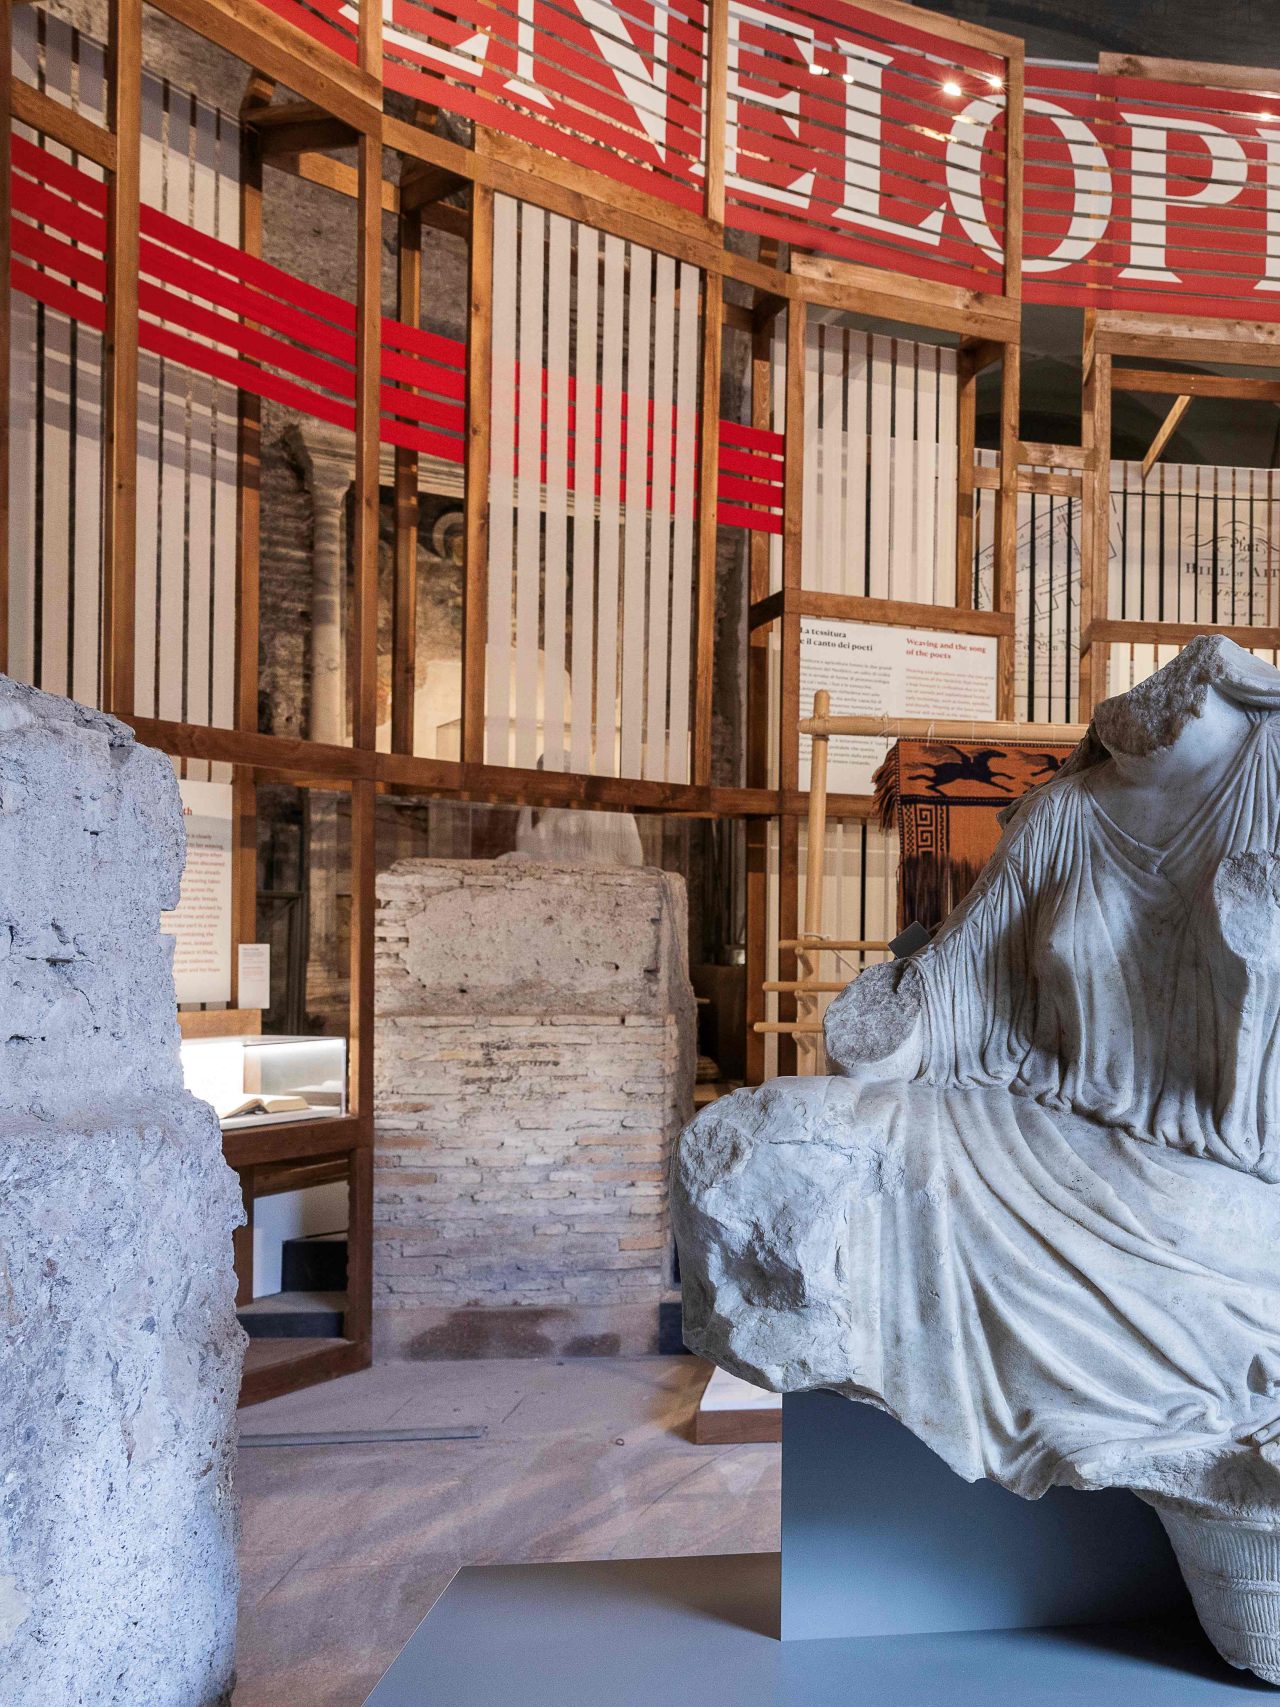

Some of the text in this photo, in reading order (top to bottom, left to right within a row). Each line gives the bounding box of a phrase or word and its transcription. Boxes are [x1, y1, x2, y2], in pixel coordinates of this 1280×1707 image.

[812, 628, 847, 638] tessitura
[852, 644, 873, 652] poeti
[906, 638, 938, 648] Weaving
[969, 646, 986, 654] song
[930, 651, 951, 659] poets
